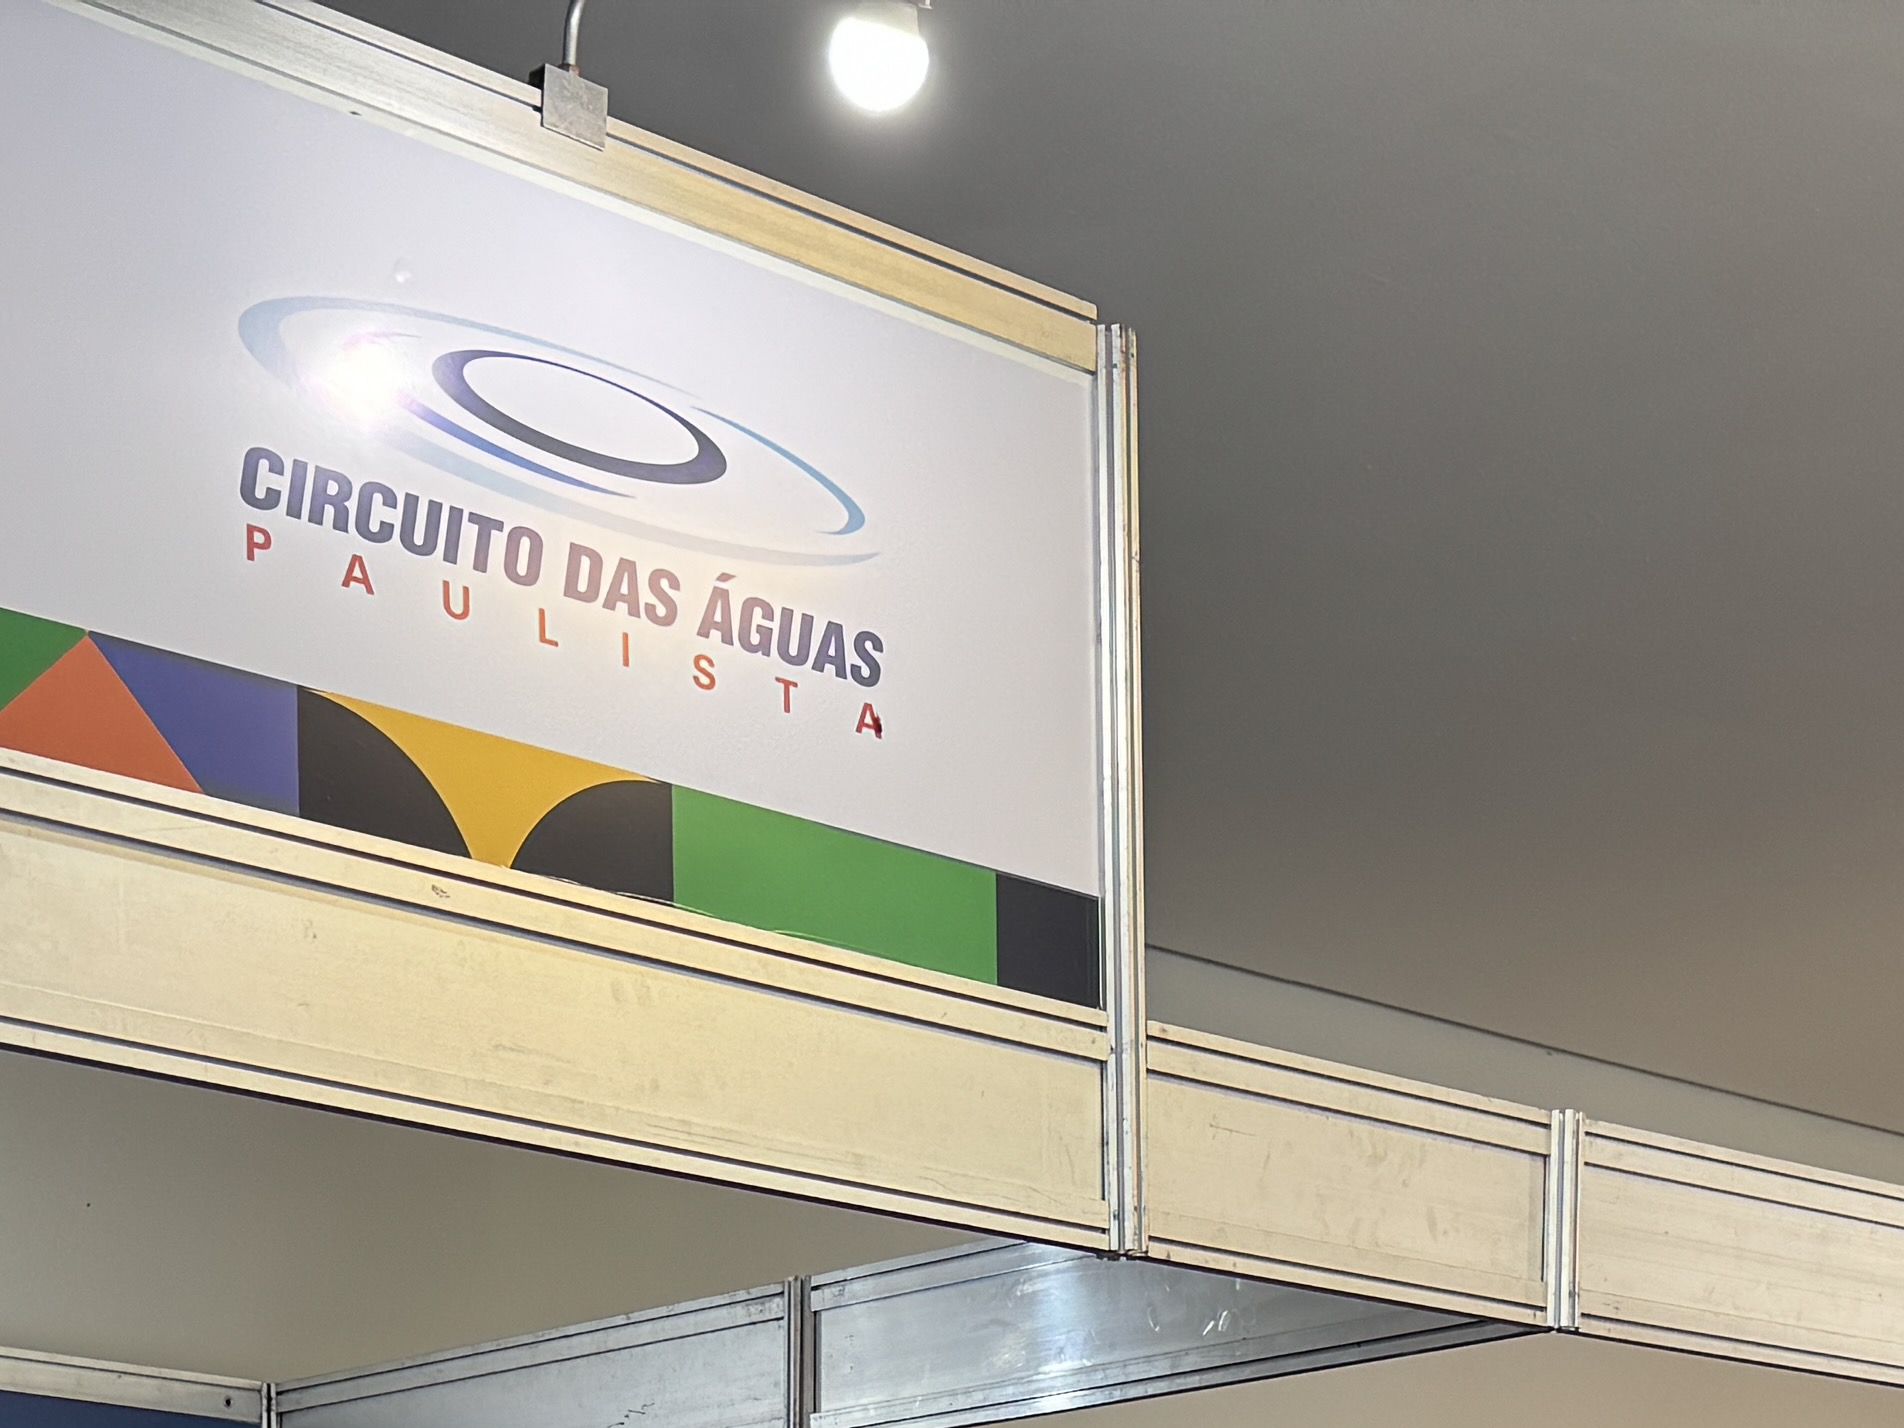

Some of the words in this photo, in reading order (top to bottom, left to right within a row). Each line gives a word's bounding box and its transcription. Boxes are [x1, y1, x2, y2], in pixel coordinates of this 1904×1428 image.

[240, 446, 543, 587] CIRCUITO
[563, 541, 681, 627] DAS
[696, 572, 884, 688] ÁGUAS
[245, 524, 883, 739] PAULISTA
